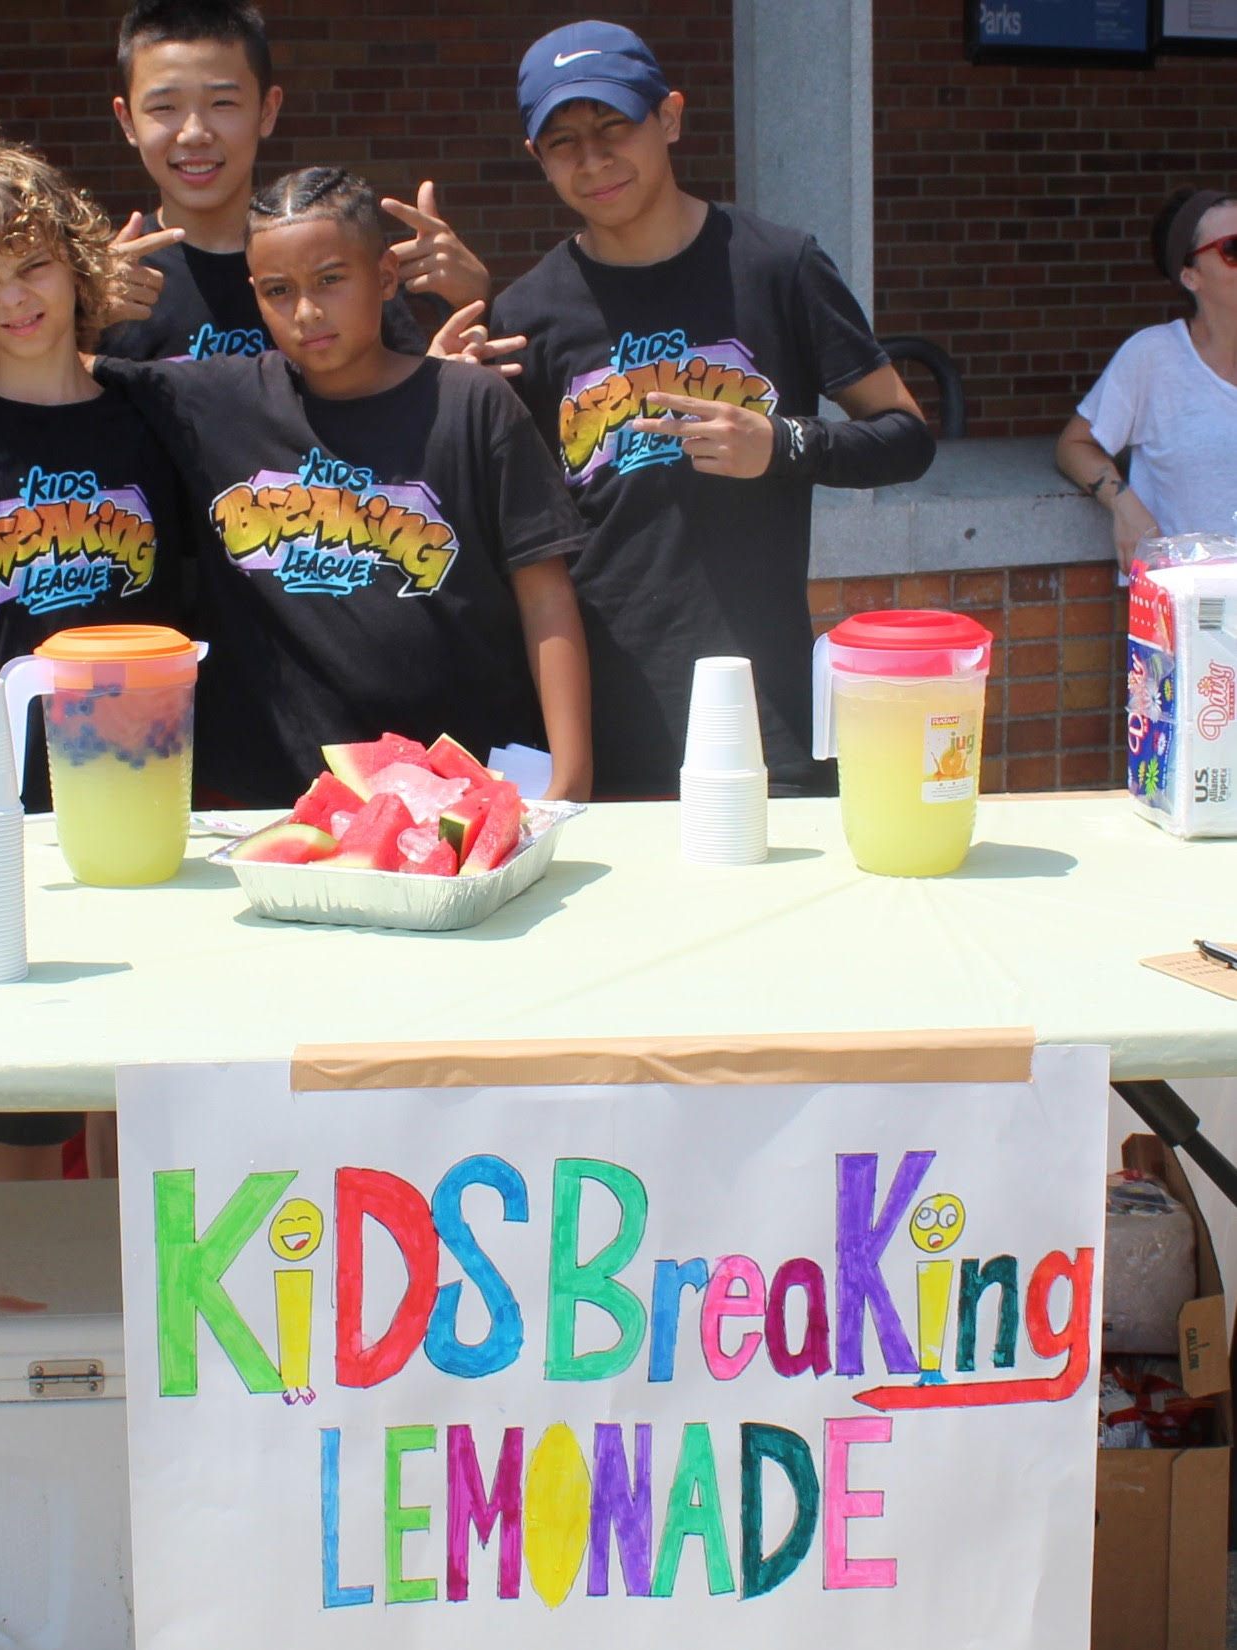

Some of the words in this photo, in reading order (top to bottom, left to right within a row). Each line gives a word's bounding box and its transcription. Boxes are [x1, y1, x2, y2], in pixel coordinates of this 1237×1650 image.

[616, 330, 687, 375] KIDS
[26, 466, 98, 509] KIDS
[301, 448, 373, 492] KIDS
[19, 564, 109, 602] LEAGUE
[277, 545, 373, 584] LEAGUE
[1197, 661, 1235, 741] Daisy
[320, 1416, 897, 1609] LEMONADE
